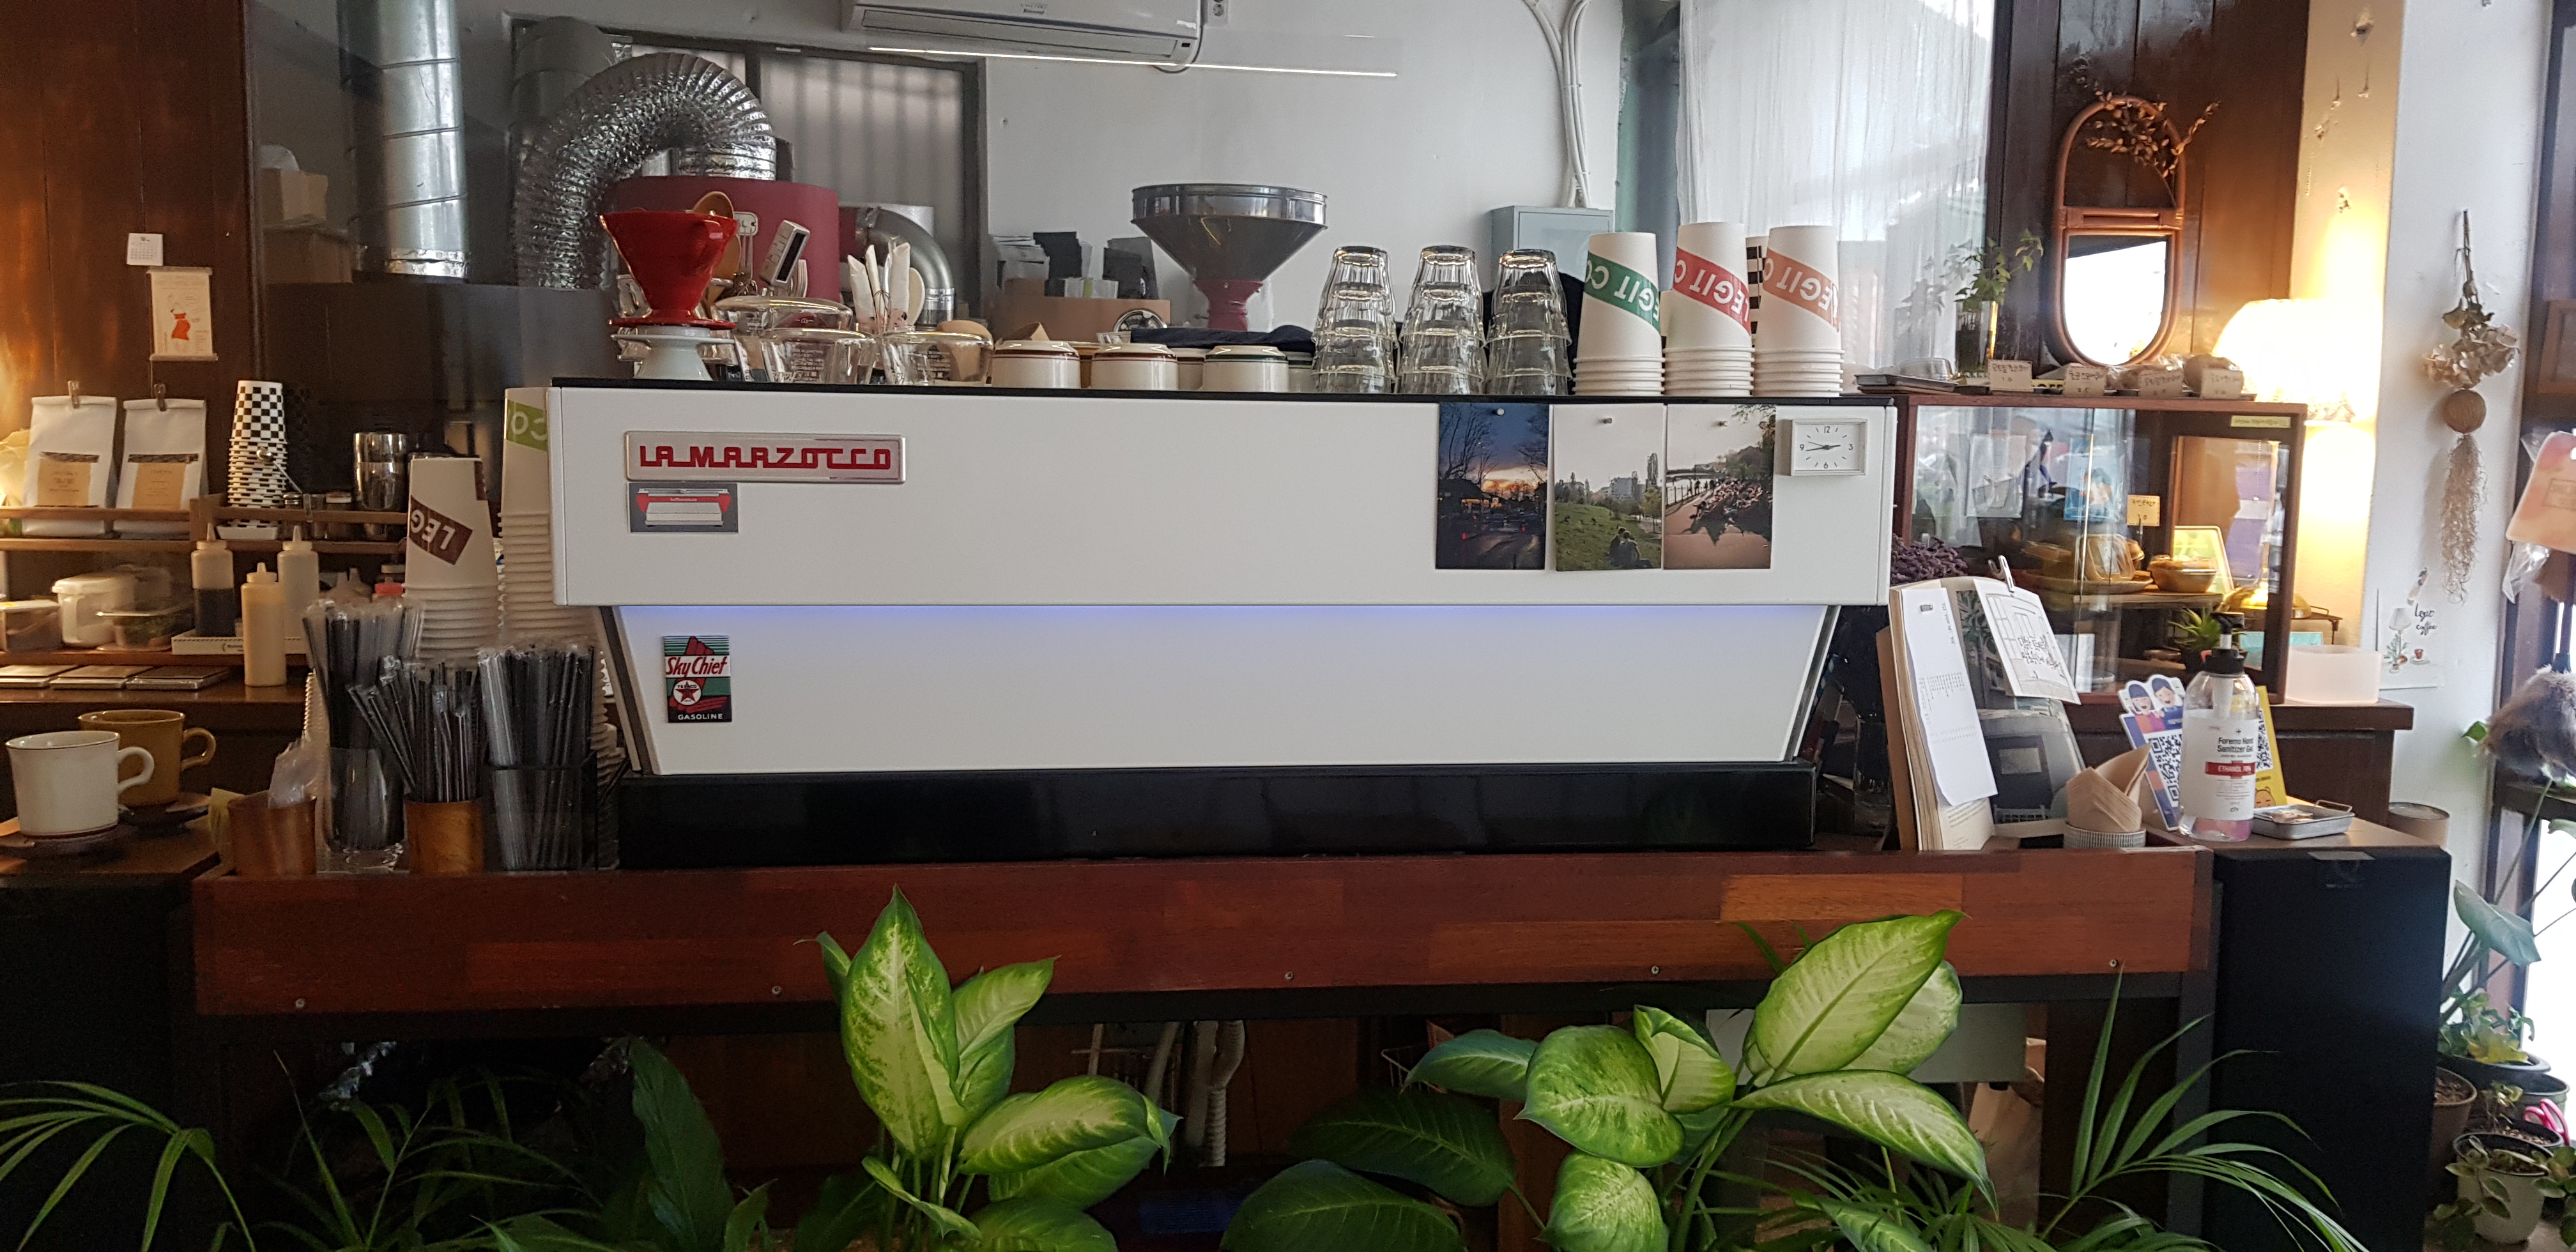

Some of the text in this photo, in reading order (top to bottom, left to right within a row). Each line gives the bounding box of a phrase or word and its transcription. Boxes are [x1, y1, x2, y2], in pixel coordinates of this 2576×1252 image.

[1823, 425, 1830, 434] 12
[640, 445, 674, 468] LA
[666, 656, 728, 677] Sky Chief
